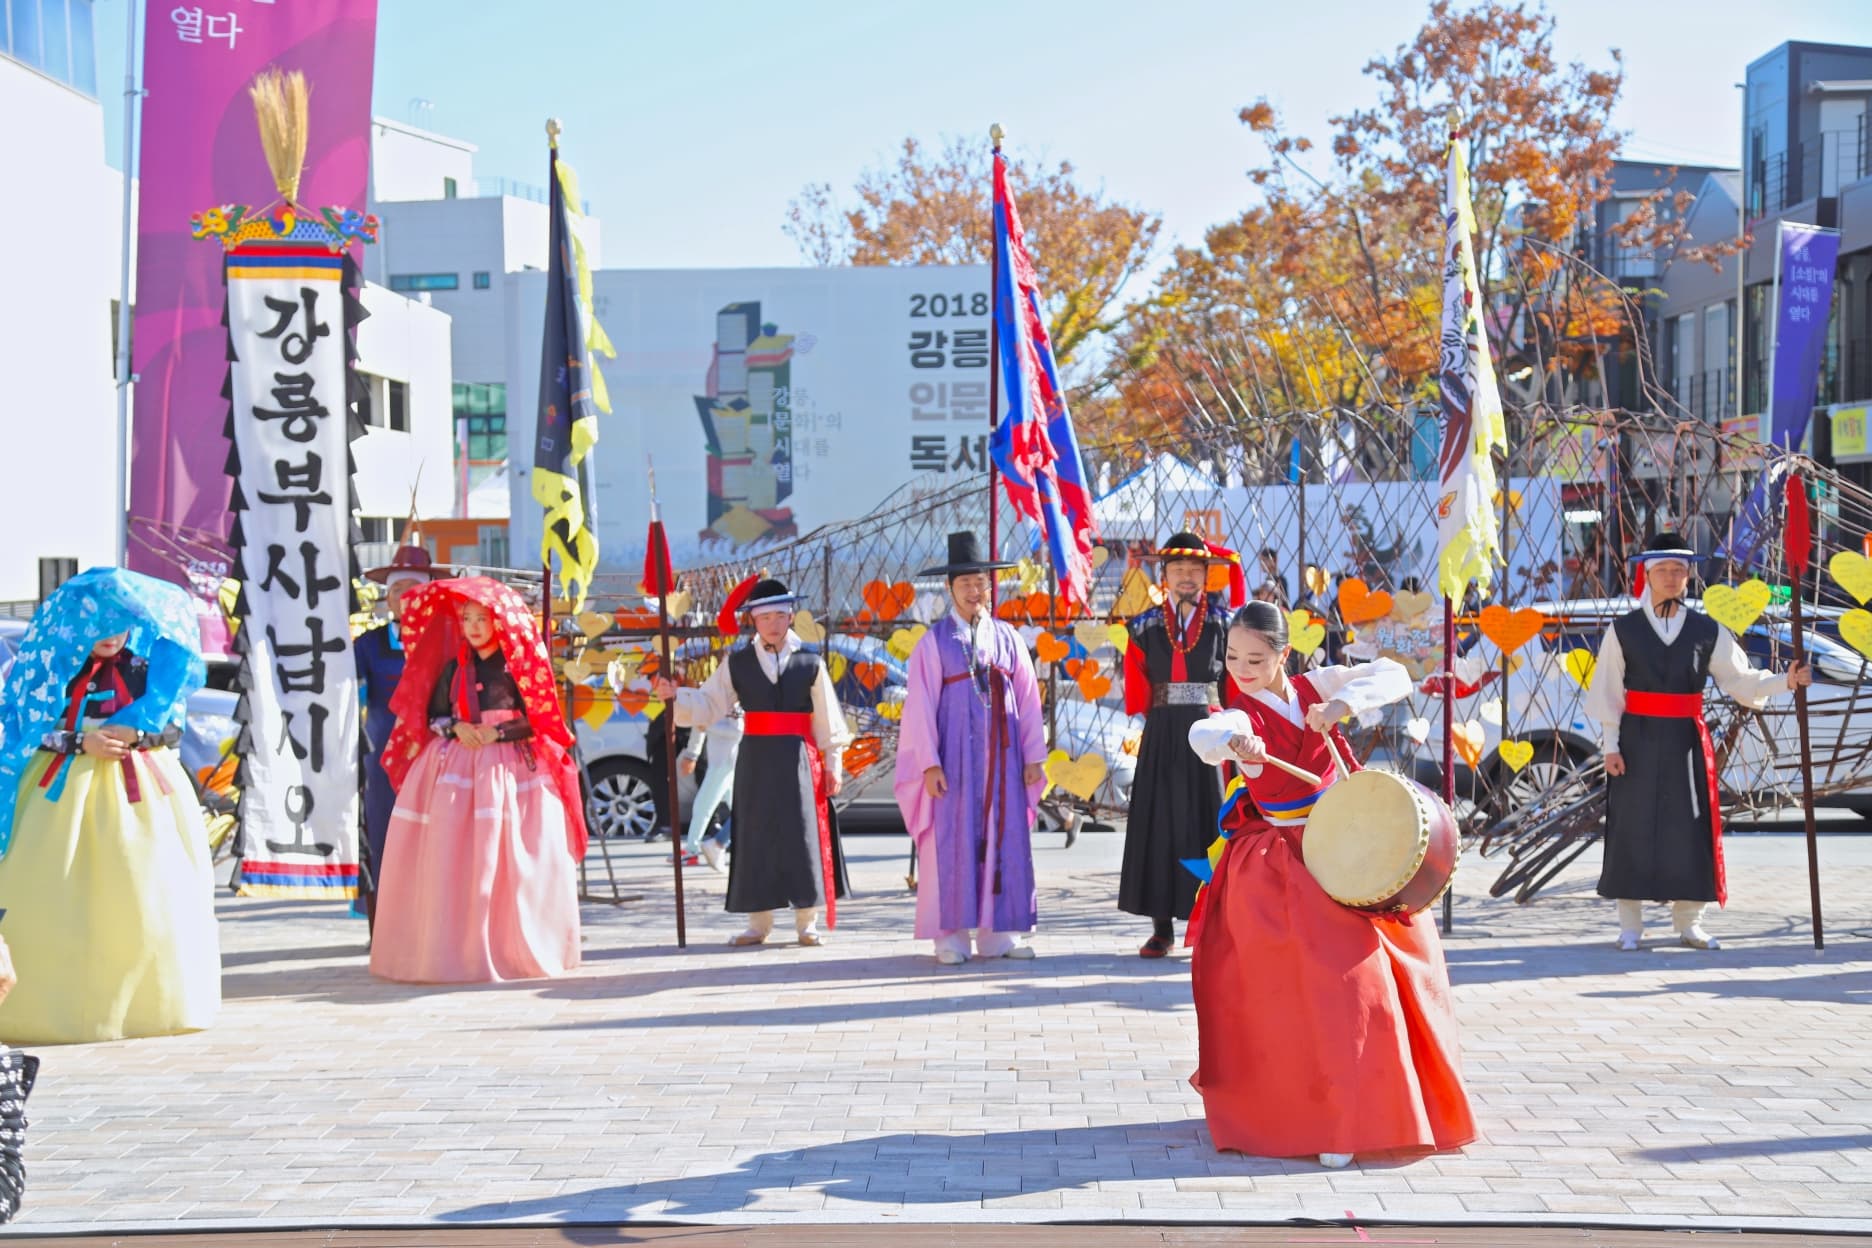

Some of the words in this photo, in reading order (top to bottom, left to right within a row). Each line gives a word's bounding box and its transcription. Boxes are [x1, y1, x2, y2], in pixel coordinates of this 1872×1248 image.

[170, 6, 244, 49] 열다
[909, 292, 988, 318] 2018
[907, 329, 989, 369] 강릉
[909, 382, 988, 421] 인문
[773, 462, 811, 482] 열다
[910, 435, 987, 473] 독서
[252, 286, 347, 857] 강릉부사납시오
